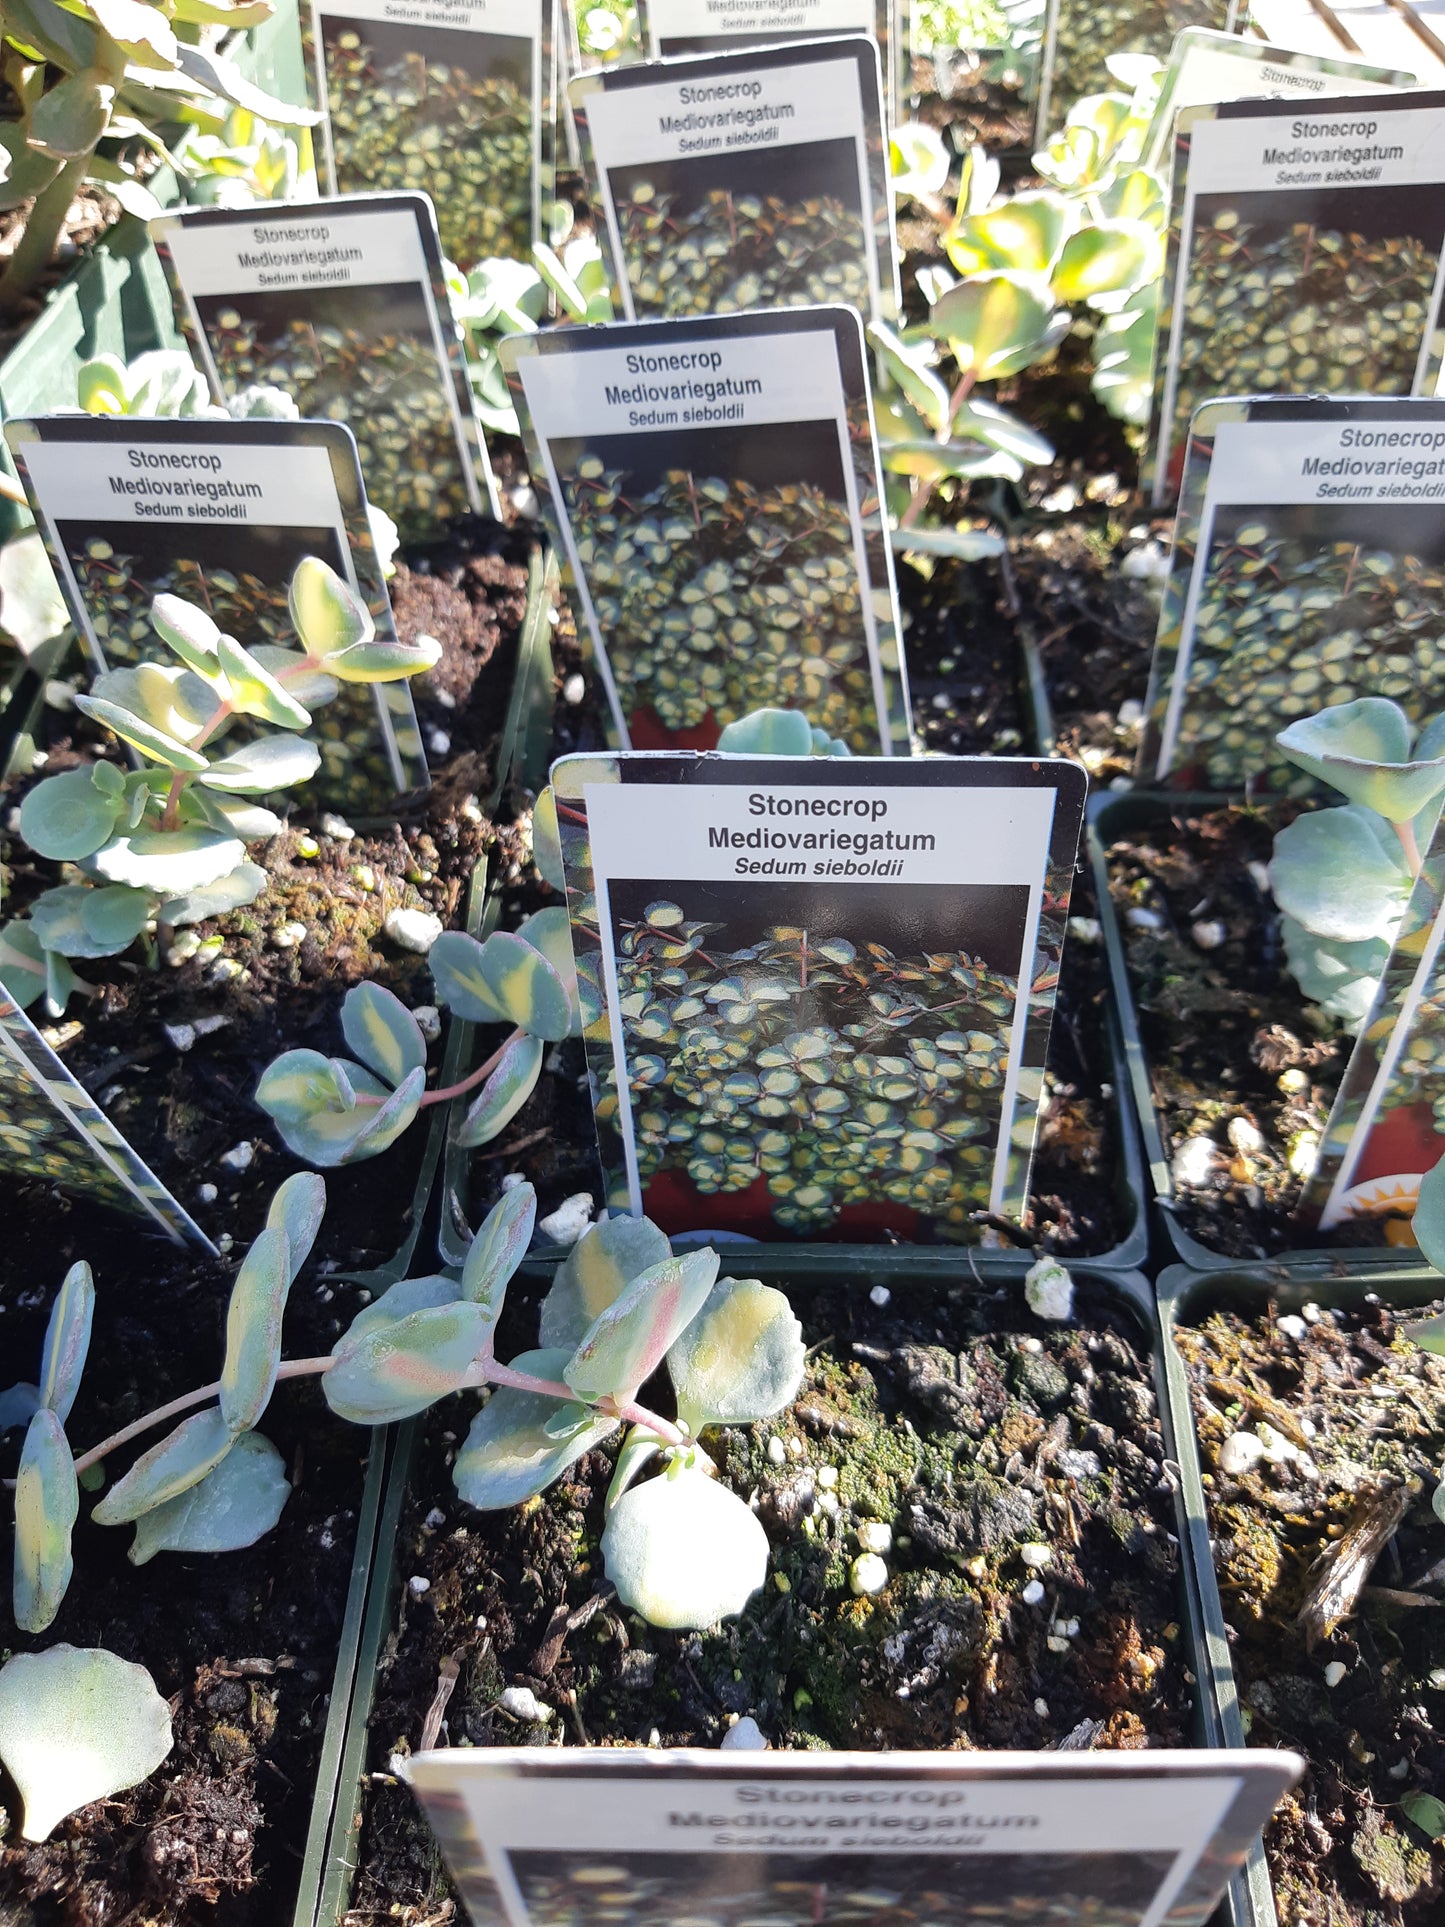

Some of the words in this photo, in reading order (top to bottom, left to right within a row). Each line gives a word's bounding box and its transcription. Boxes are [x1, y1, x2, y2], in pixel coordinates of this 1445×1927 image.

[679, 80, 762, 105] Stonecrop
[659, 103, 795, 134] Mediovariegatum
[1291, 121, 1377, 139] Stonecrop
[679, 136, 722, 152] Sedum
[1263, 145, 1403, 165] Mediovariegatum
[1275, 171, 1321, 184] Sedum
[253, 225, 329, 244] Stonecrop
[237, 247, 362, 268] Mediovariegatum
[258, 274, 298, 286] Sedum
[626, 350, 722, 374] Stonecrop
[605, 377, 763, 406] Mediovariegatum
[629, 410, 679, 426] Sedum
[683, 404, 744, 422] sieboldii
[1340, 428, 1445, 451] Stonecrop
[128, 450, 221, 473] Stonecrop
[109, 476, 262, 501] Mediovariegatum
[1317, 483, 1373, 498] Sedum
[135, 502, 183, 517] Sedum
[187, 504, 246, 519] sieboldii
[748, 794, 888, 821] Stonecrop
[708, 827, 935, 855] Mediovariegatum
[735, 857, 806, 875] Sedum
[813, 859, 903, 877] sieboldii
[735, 1786, 966, 1808] Stonecrop
[668, 1811, 1042, 1831] Mediovariegatum
[714, 1833, 830, 1846] Sedum
[841, 1833, 986, 1847] sieboldii
